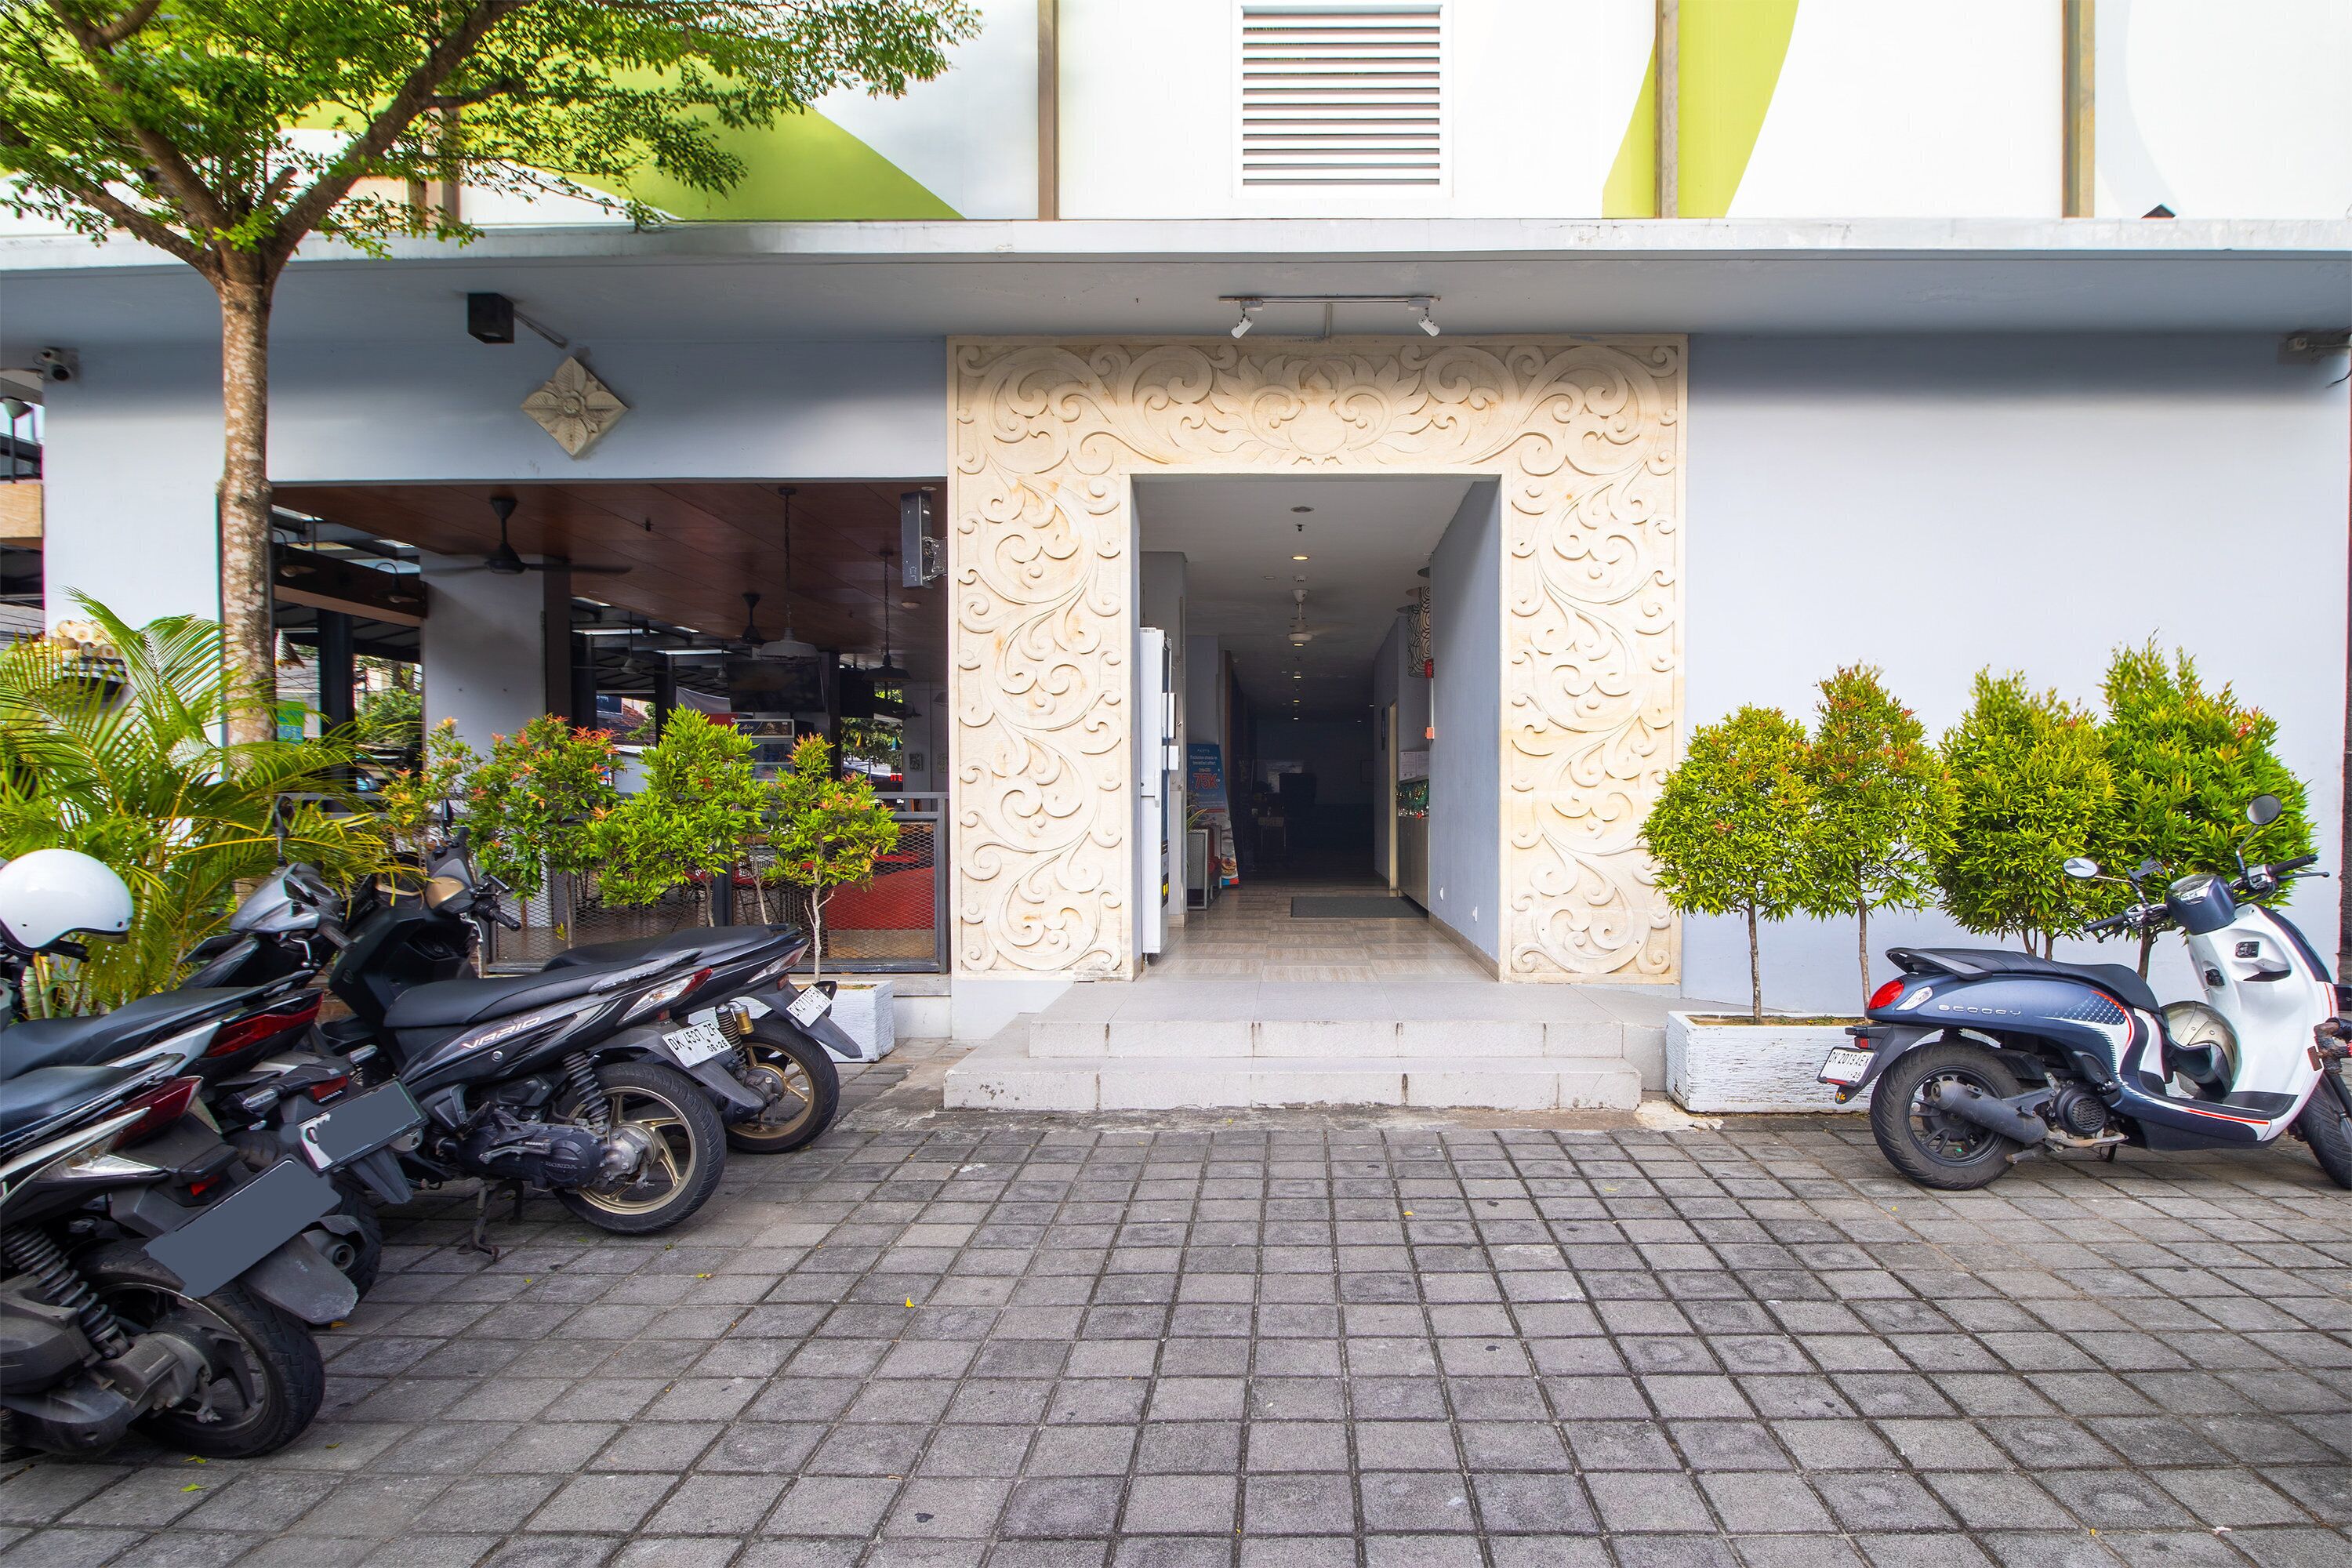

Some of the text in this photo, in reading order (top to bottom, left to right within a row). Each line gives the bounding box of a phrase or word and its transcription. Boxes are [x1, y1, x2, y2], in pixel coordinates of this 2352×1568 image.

[1193, 773, 1219, 789] 75K
[462, 1017, 541, 1049] VARIO
[668, 1023, 717, 1051] DK 4537 ZF
[1828, 1051, 1841, 1064] DK
[545, 1161, 578, 1170] HONDA
